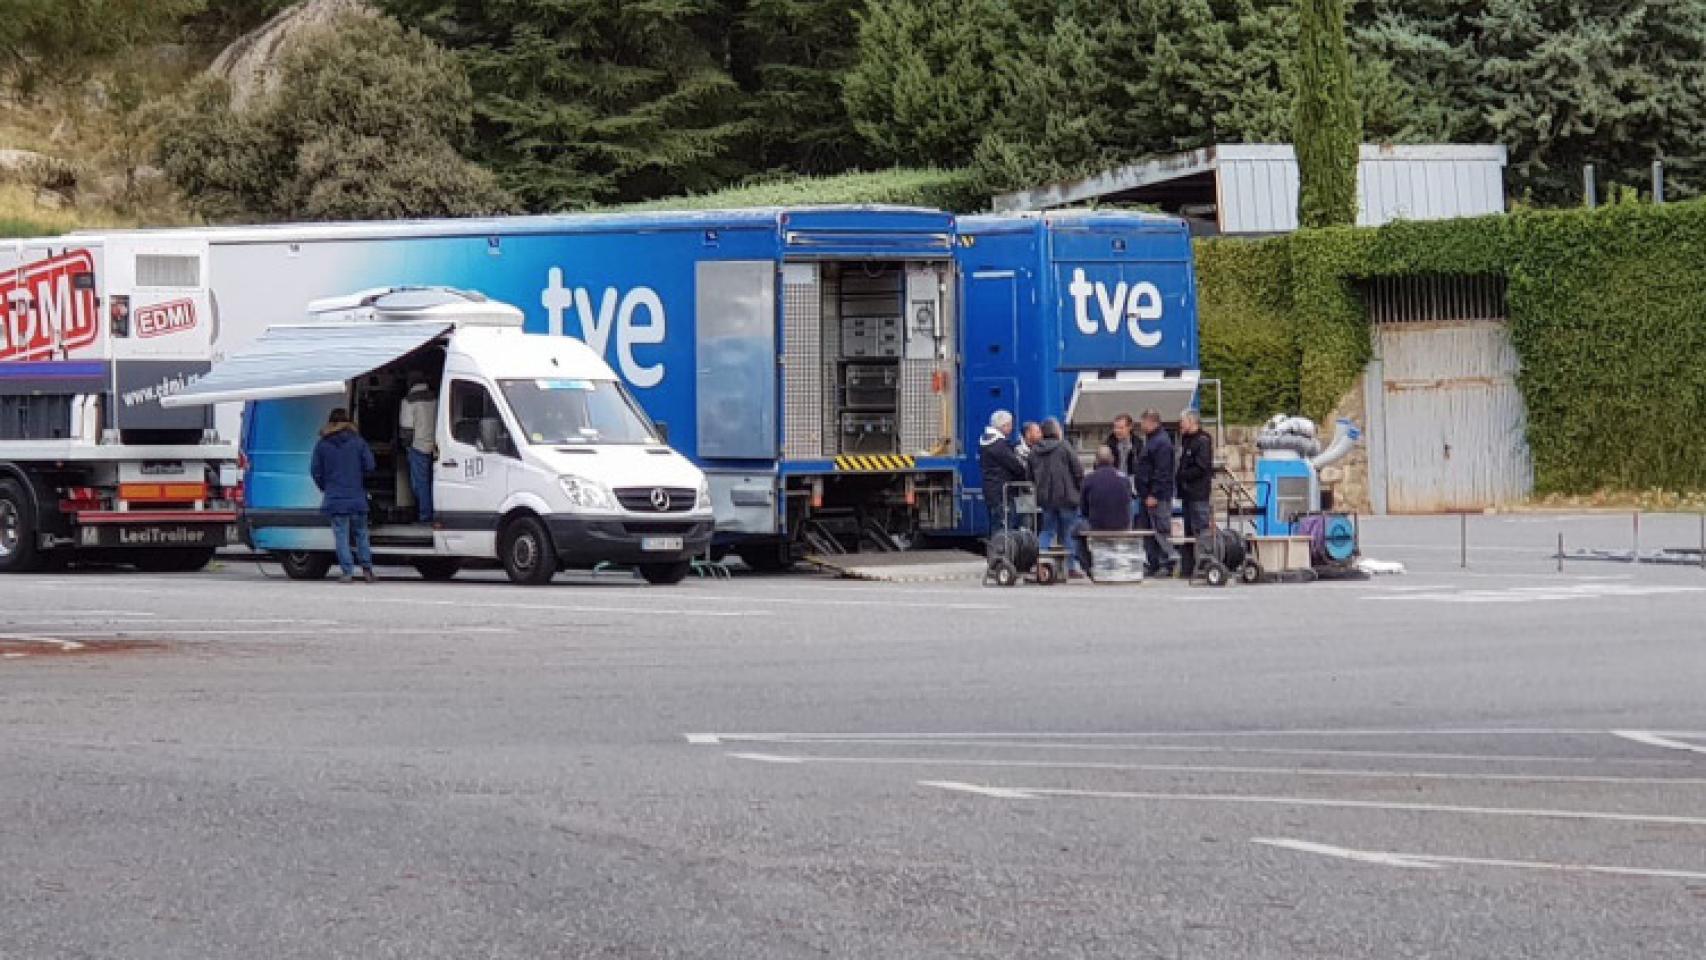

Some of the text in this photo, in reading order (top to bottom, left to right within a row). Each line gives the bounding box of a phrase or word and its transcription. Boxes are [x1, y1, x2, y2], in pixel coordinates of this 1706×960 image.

[140, 304, 189, 332] EDMI
[541, 266, 666, 387] tve
[1069, 267, 1162, 348] tve
[465, 456, 484, 477] HD
